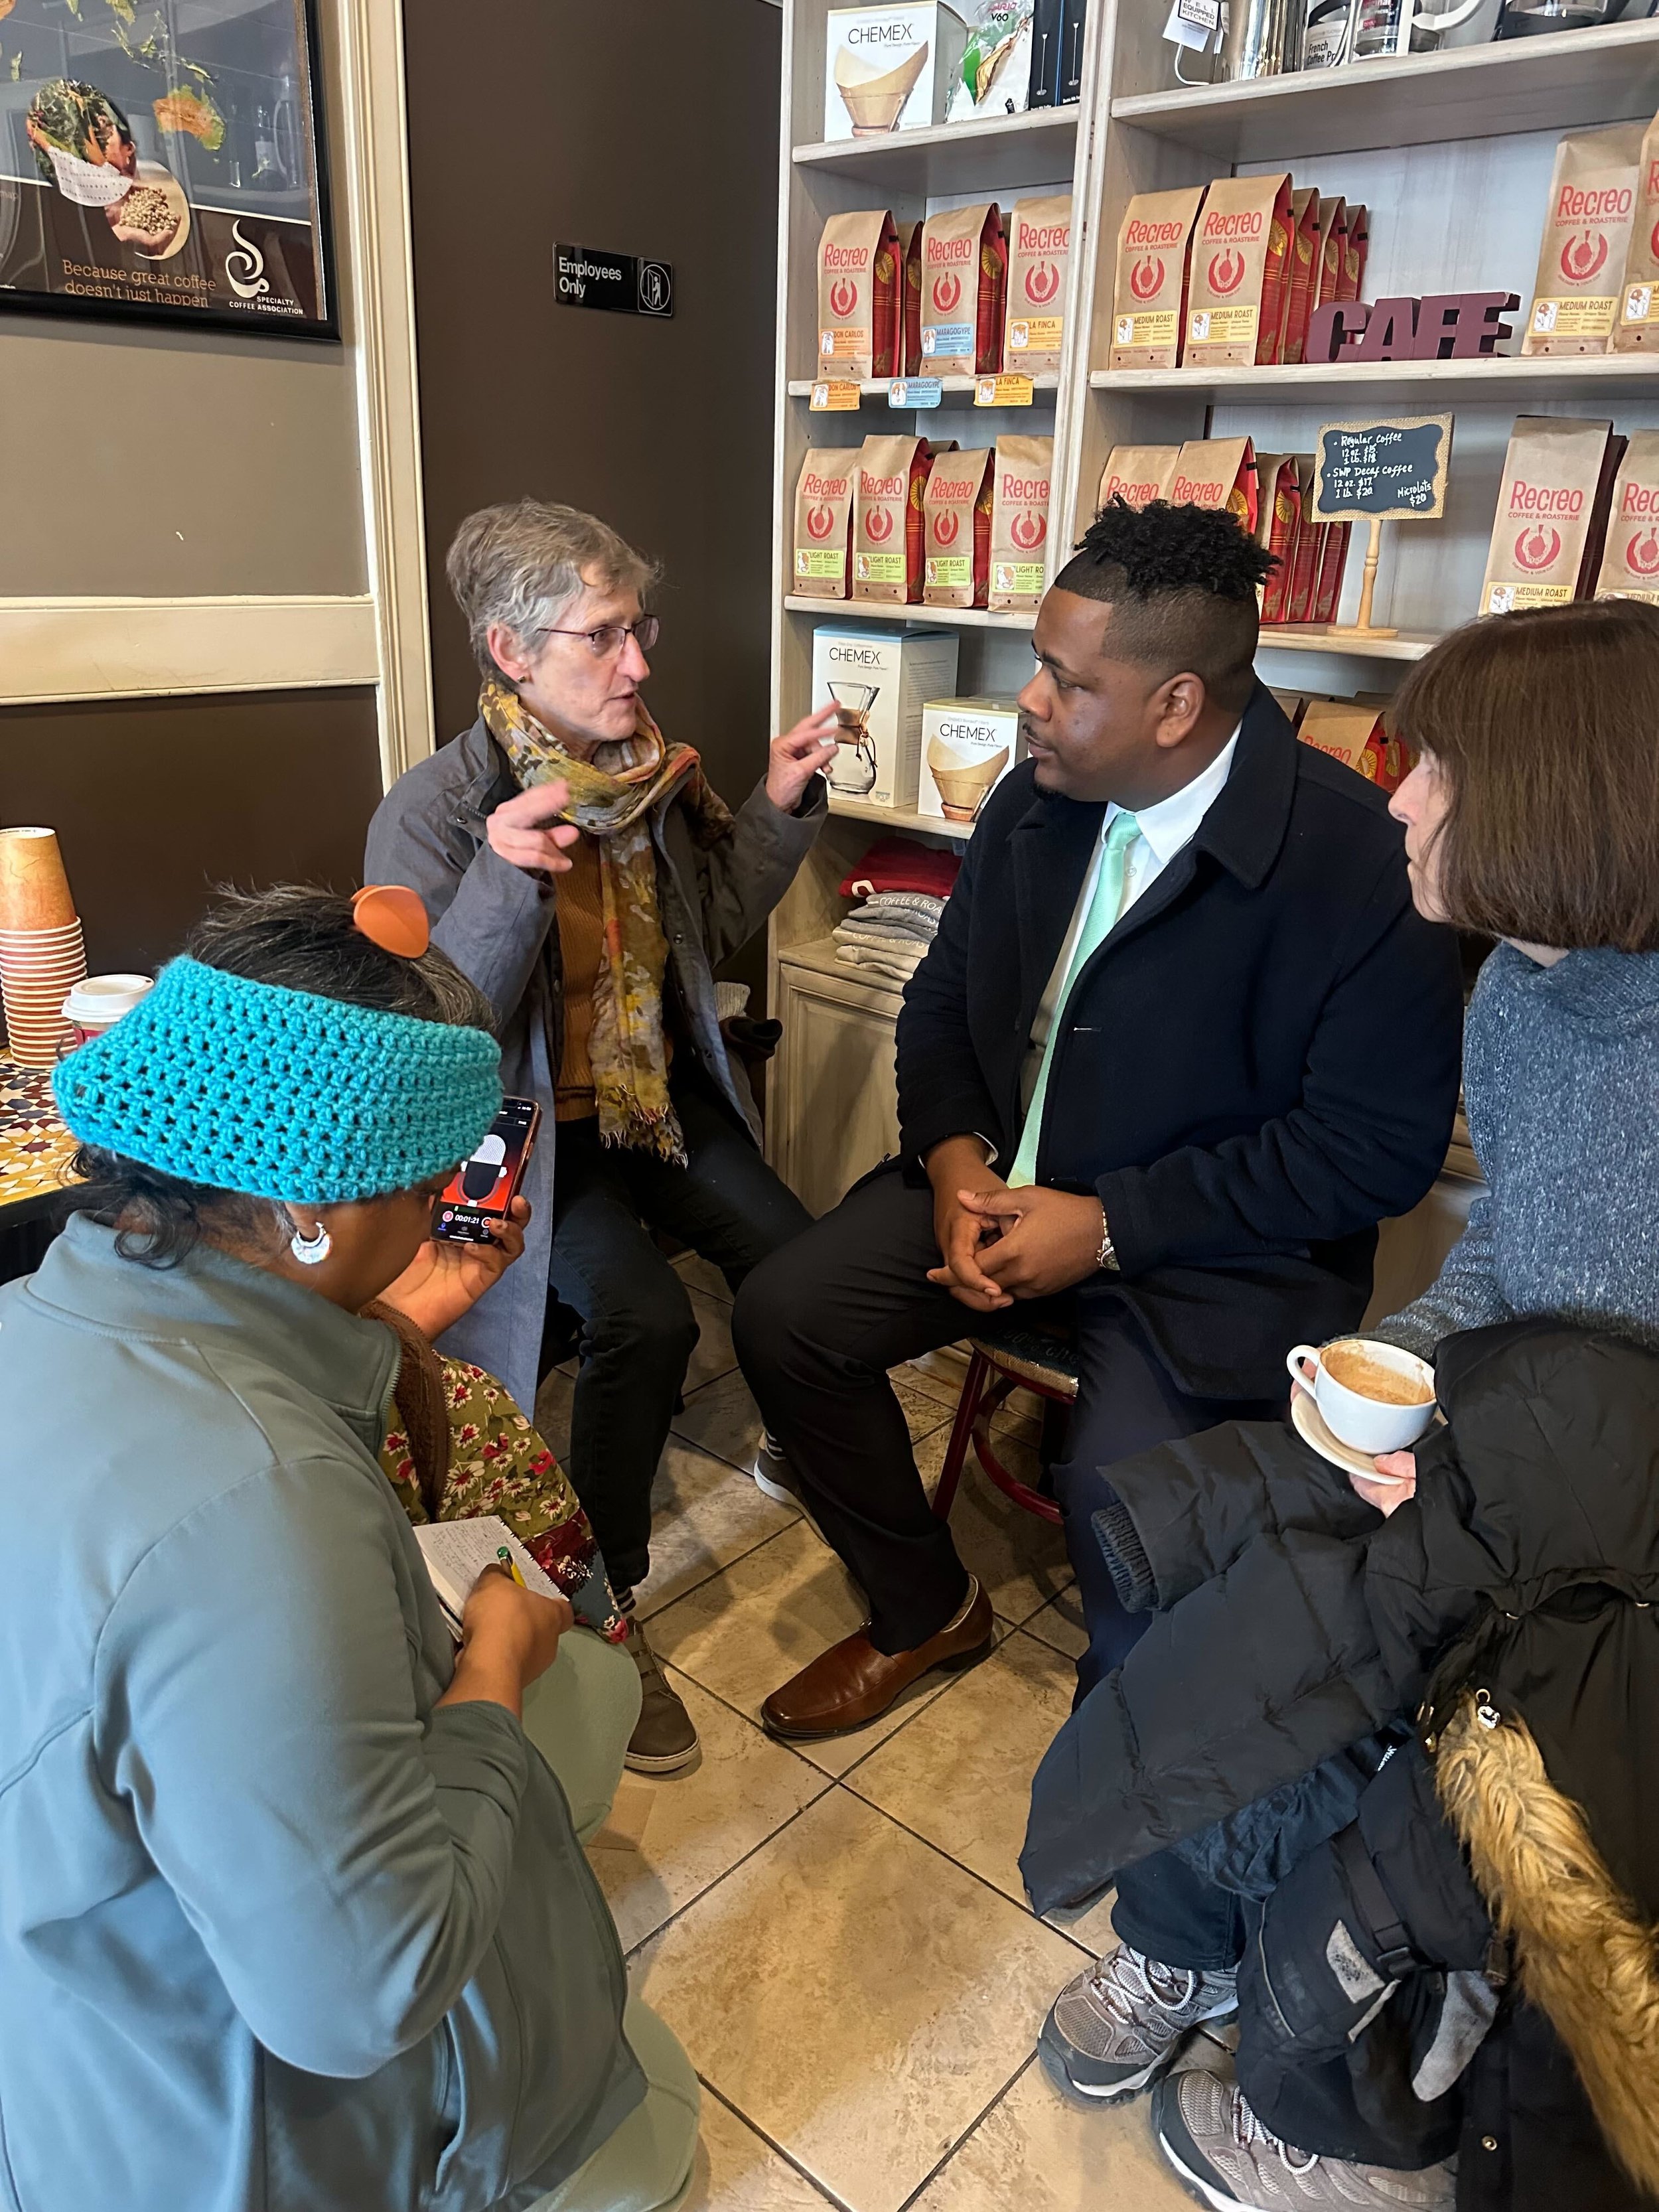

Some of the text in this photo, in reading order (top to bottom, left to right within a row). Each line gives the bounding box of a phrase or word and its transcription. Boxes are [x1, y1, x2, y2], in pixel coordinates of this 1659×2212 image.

[1183, 3, 1214, 19] EQUIPPED
[1183, 9, 1214, 25] KITCHEN
[848, 23, 912, 44] CHEMEX
[1309, 40, 1328, 54] French
[1307, 53, 1325, 65] Coffee
[1557, 185, 1632, 217] Recreo
[1203, 212, 1262, 236] Recreo
[1555, 218, 1580, 227] COFFEE
[1126, 220, 1183, 244] Recreo
[825, 244, 868, 266] Recreo
[928, 237, 972, 261] Recreo
[62, 259, 216, 291] Because great coffee
[559, 257, 622, 280] Employees
[65, 280, 121, 299] doesn't
[125, 285, 151, 302] just
[559, 277, 586, 298] Only
[229, 301, 303, 315] COFFEE ASSOCIATION
[257, 296, 294, 306] SPECIALTY
[1559, 301, 1613, 311] MEDIUM ROAST
[1134, 314, 1173, 324] MEDIUM ROAST
[1211, 309, 1253, 320] MEDIUM ROAST
[1039, 321, 1055, 329] FINCA
[1004, 377, 1019, 386] FINCA
[1340, 433, 1373, 448] Regular
[1342, 448, 1350, 457] 12
[1333, 467, 1351, 477] SWP
[1354, 466, 1380, 478] Decaf
[804, 473, 847, 496] Recreo
[861, 470, 902, 495] Recreo
[931, 477, 974, 498] Recreo
[1003, 474, 1050, 499] Recre
[1173, 476, 1224, 502] Recreo
[1334, 479, 1344, 488] 12
[1409, 493, 1427, 507] $20
[1510, 480, 1583, 512] Recreo
[1623, 482, 1659, 514] Rec
[1516, 587, 1567, 597] MEDIUM ROAST
[830, 647, 881, 665] CHEMEX
[940, 723, 995, 742] CHEMEX
[879, 896, 920, 907] COFFEE &
[455, 1215, 480, 1224] 00:01:21
